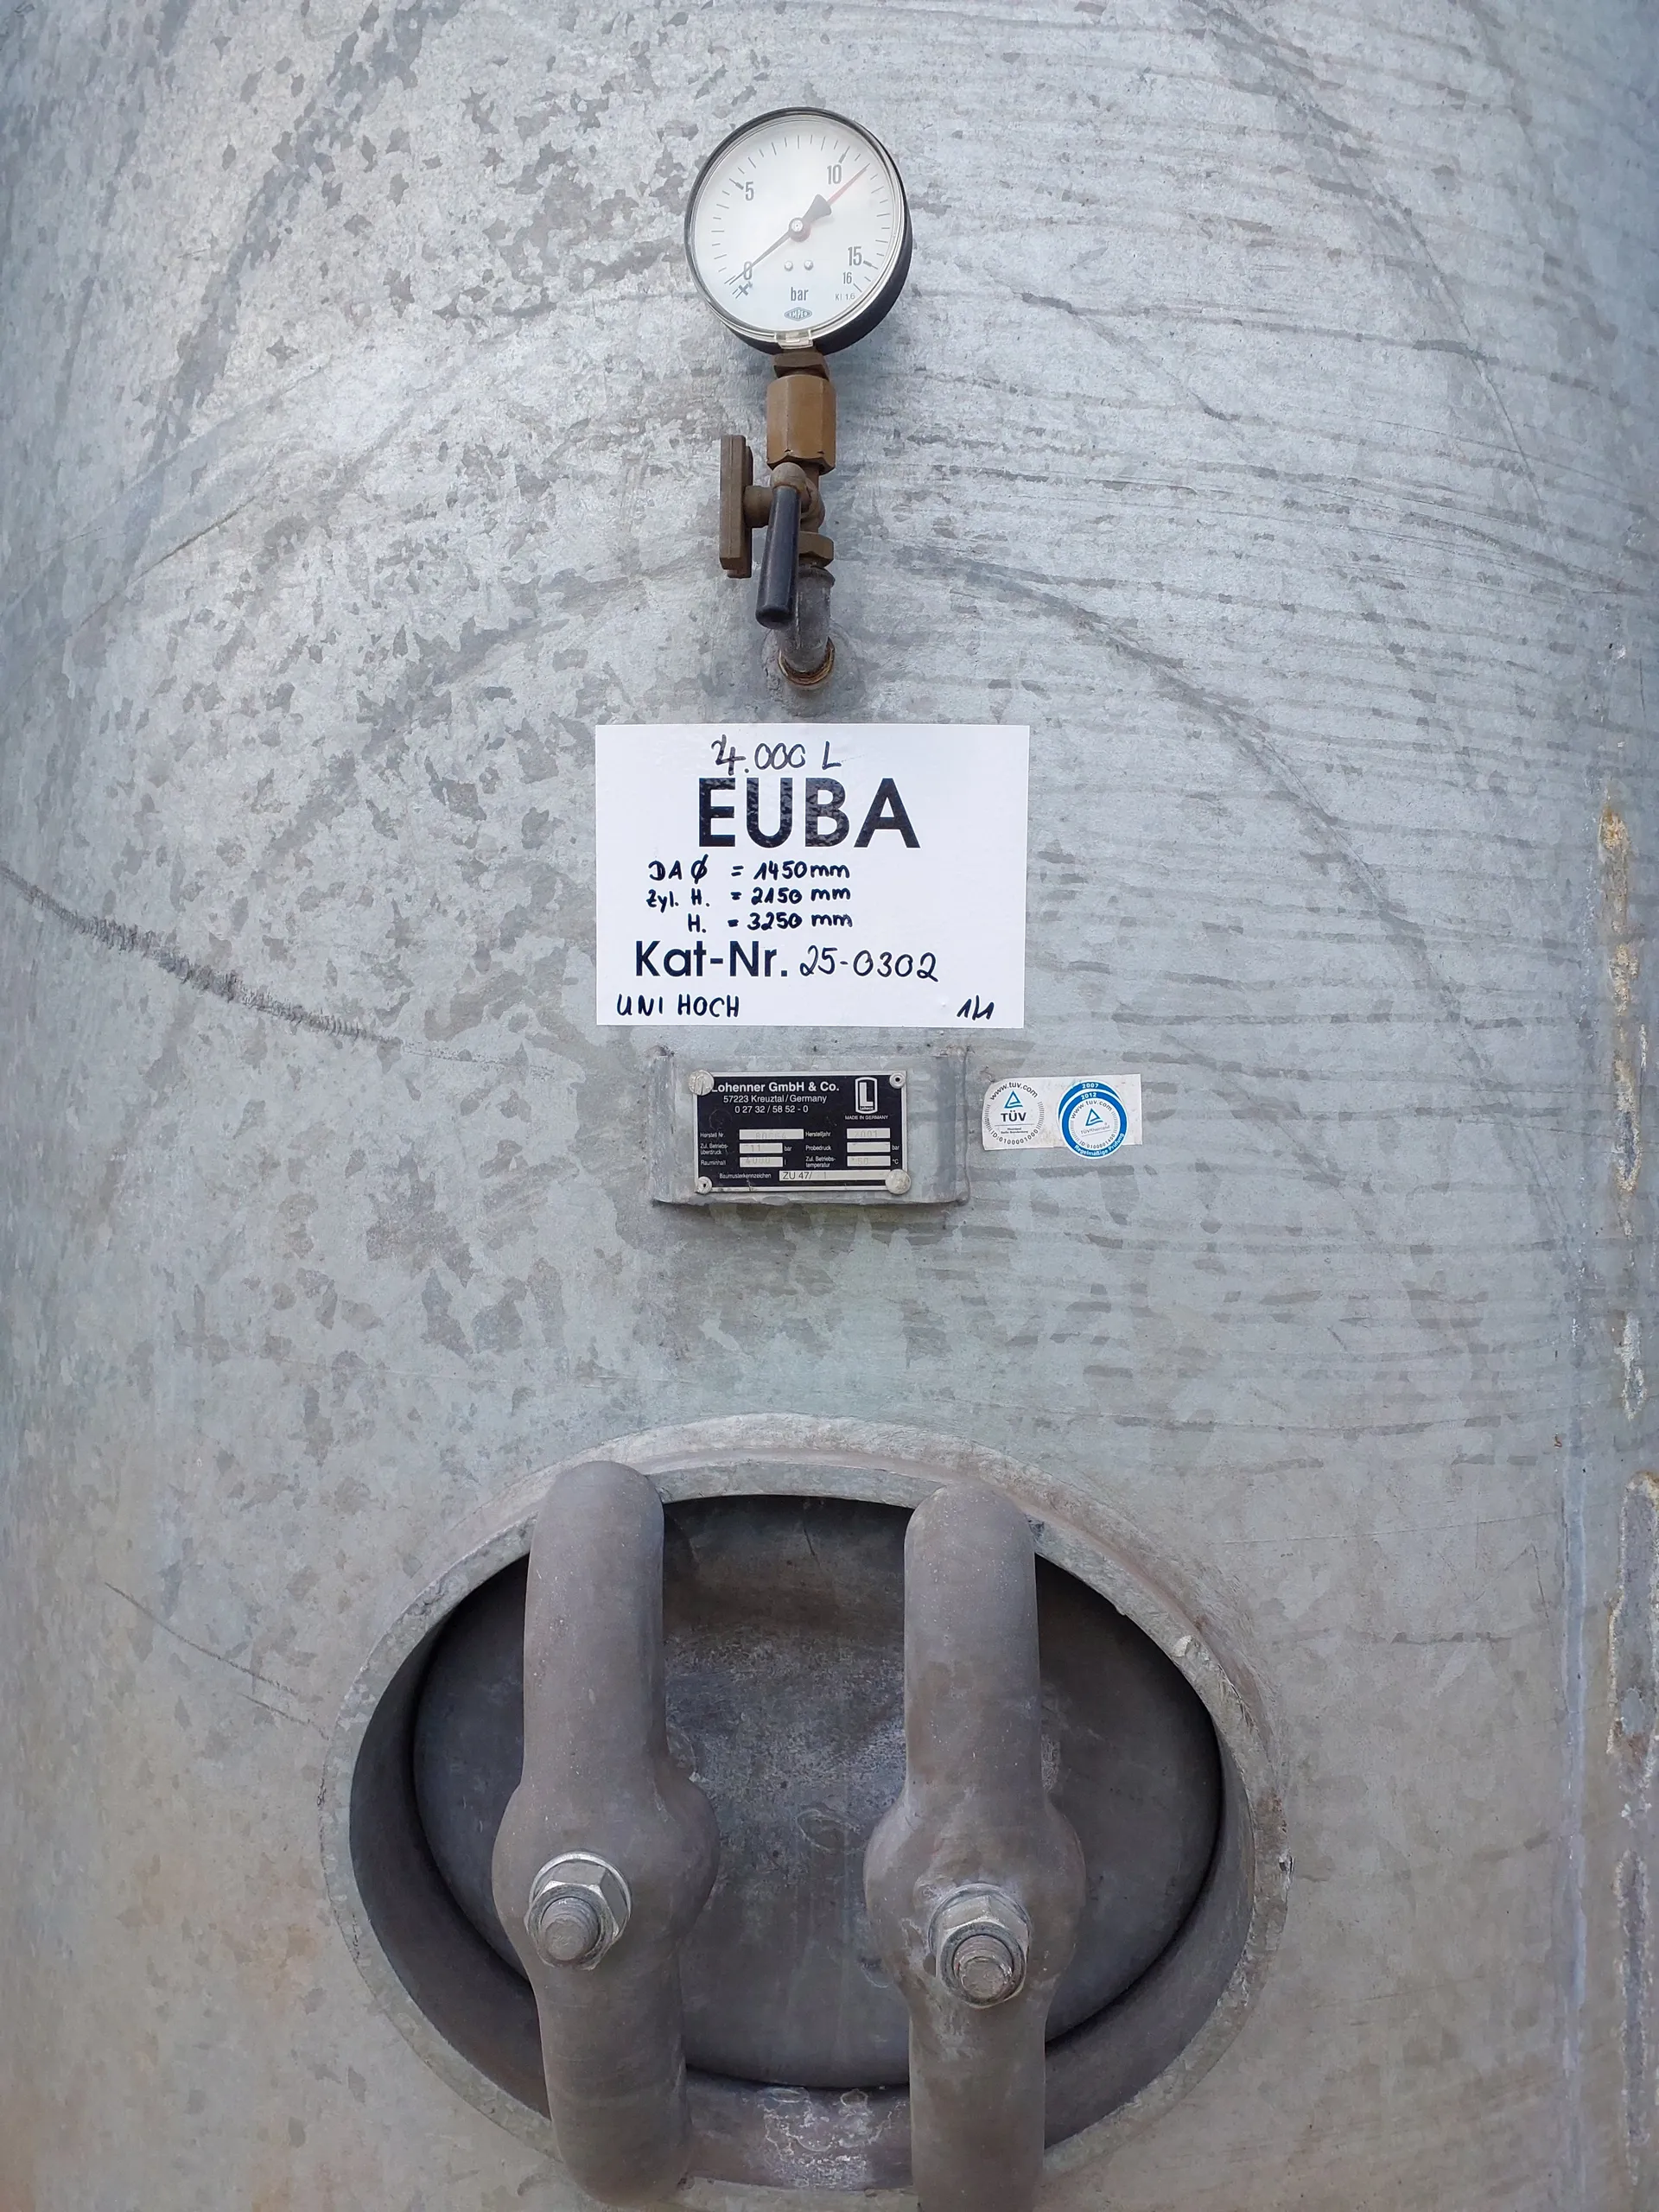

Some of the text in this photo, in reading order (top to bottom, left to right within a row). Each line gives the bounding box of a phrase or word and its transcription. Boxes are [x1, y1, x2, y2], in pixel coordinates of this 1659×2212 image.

[827, 164, 842, 184] 10
[745, 181, 754, 200] 5
[848, 246, 862, 266] 15
[743, 261, 753, 280] 0
[842, 272, 852, 284] 16
[791, 287, 808, 301] bar
[822, 741, 842, 769] L
[698, 778, 920, 849] EUBA
[691, 888, 709, 906] H.
[751, 887, 802, 906] 2150
[810, 887, 850, 901] mm
[688, 913, 707, 933] H.
[747, 912, 803, 930] 3250
[811, 913, 853, 927] mm
[635, 940, 938, 982] Kat-Nr. 25-0302
[617, 995, 740, 1017] UNI HOCH
[712, 1082, 840, 1093] ohenner GmbH & Co.
[990, 1082, 1038, 1101] www.tuv.com
[1001, 1110, 1027, 1122] TÜV
[1071, 1100, 1112, 1119] www.tuv.com
